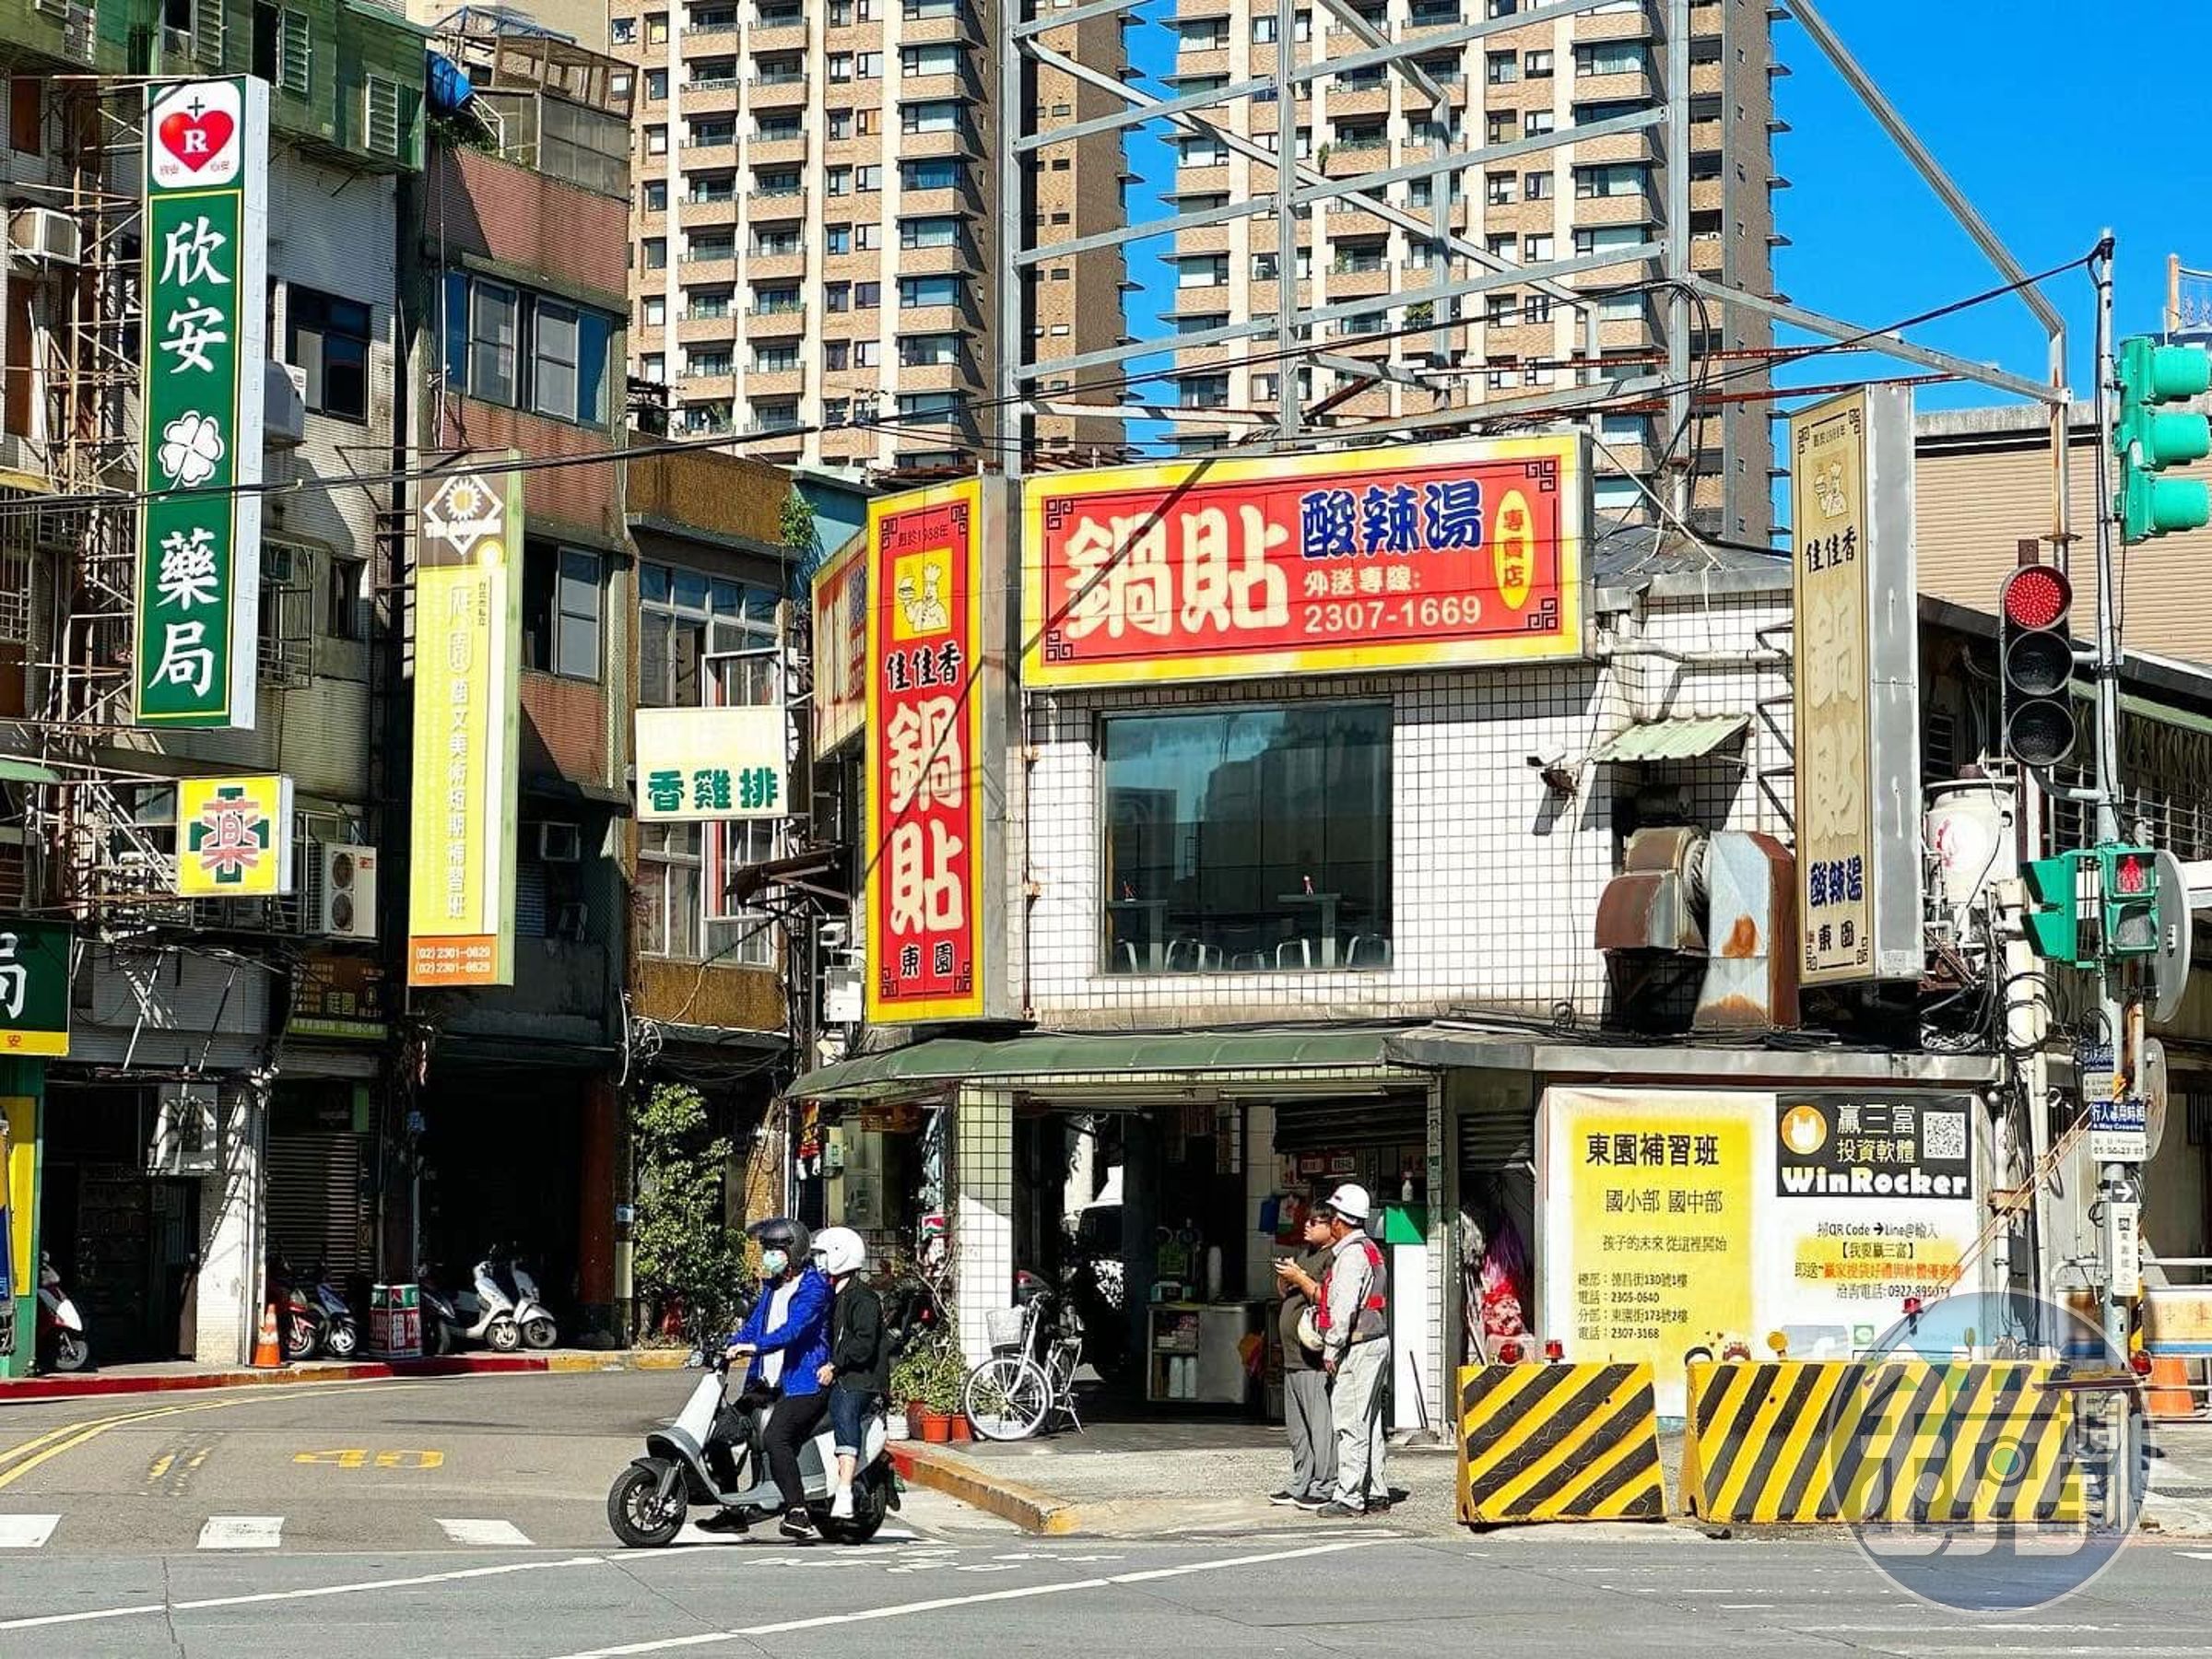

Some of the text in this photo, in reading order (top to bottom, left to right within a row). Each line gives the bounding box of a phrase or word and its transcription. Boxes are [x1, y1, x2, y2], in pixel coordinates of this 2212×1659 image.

[147, 216, 231, 698] 欣安 藥局
[1300, 480, 1483, 559] 酸辣湯
[1806, 526, 1858, 574] 佳佳香
[1065, 505, 1290, 639] 鍋貼
[1304, 595, 1482, 634] 2307-1669
[886, 642, 961, 690] 佳佳香
[1809, 588, 1859, 841] 鍋貼
[648, 767, 778, 812] 香雞排
[888, 695, 963, 935] 鍋貼
[1810, 854, 1863, 908] 酸辣湯
[1818, 920, 1855, 952] 東園
[901, 942, 954, 978] 東園
[1837, 1104, 1915, 1135] 贏三富
[1586, 1133, 1719, 1167] 東園補習班
[1837, 1138, 1915, 1163] 投資軟體
[1606, 1189, 1724, 1214] 國小部 國中部
[1781, 1167, 1967, 1194] WinRocker
[1846, 1223, 1870, 1237] Code
